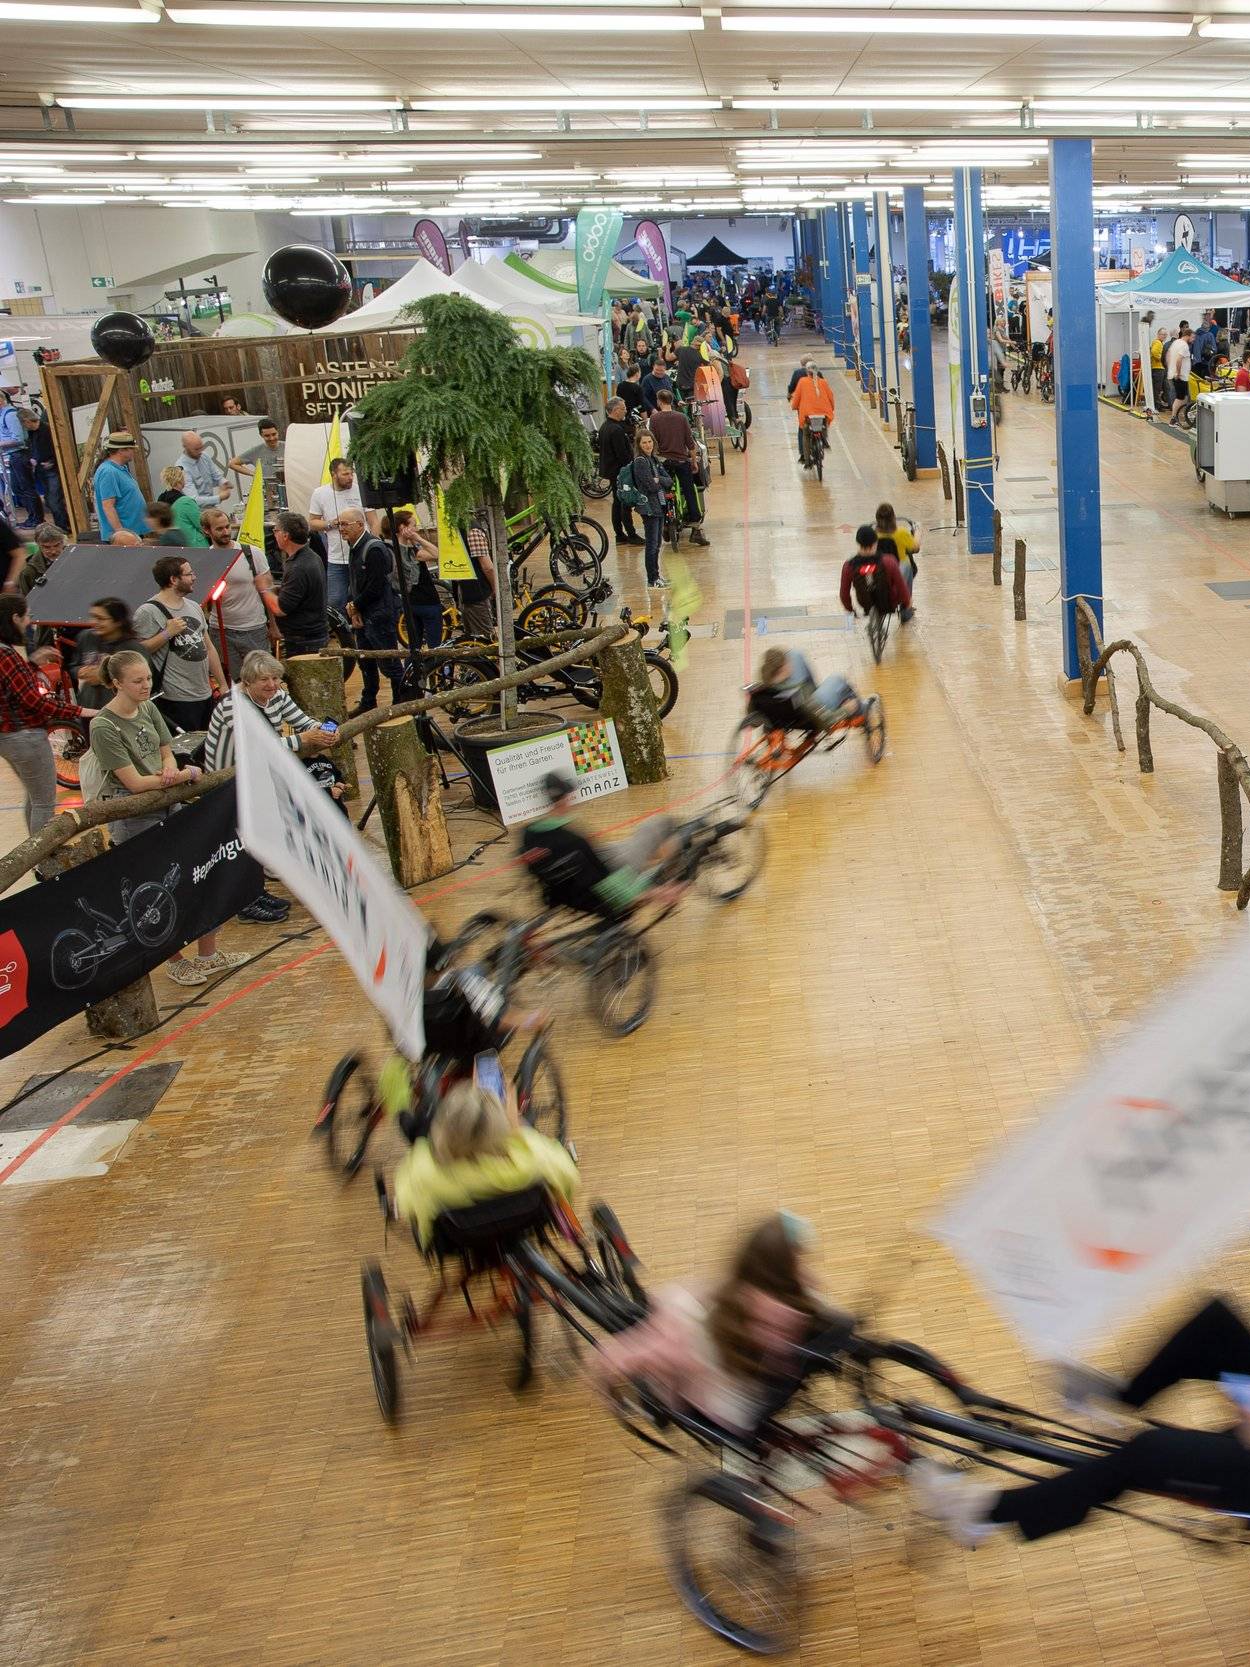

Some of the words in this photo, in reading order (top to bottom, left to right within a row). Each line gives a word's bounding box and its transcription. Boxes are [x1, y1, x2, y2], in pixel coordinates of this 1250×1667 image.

[495, 752, 524, 766] Qualität
[525, 748, 539, 758] und
[540, 742, 564, 754] Freude
[497, 767, 507, 775] für
[509, 761, 528, 772] Ihren
